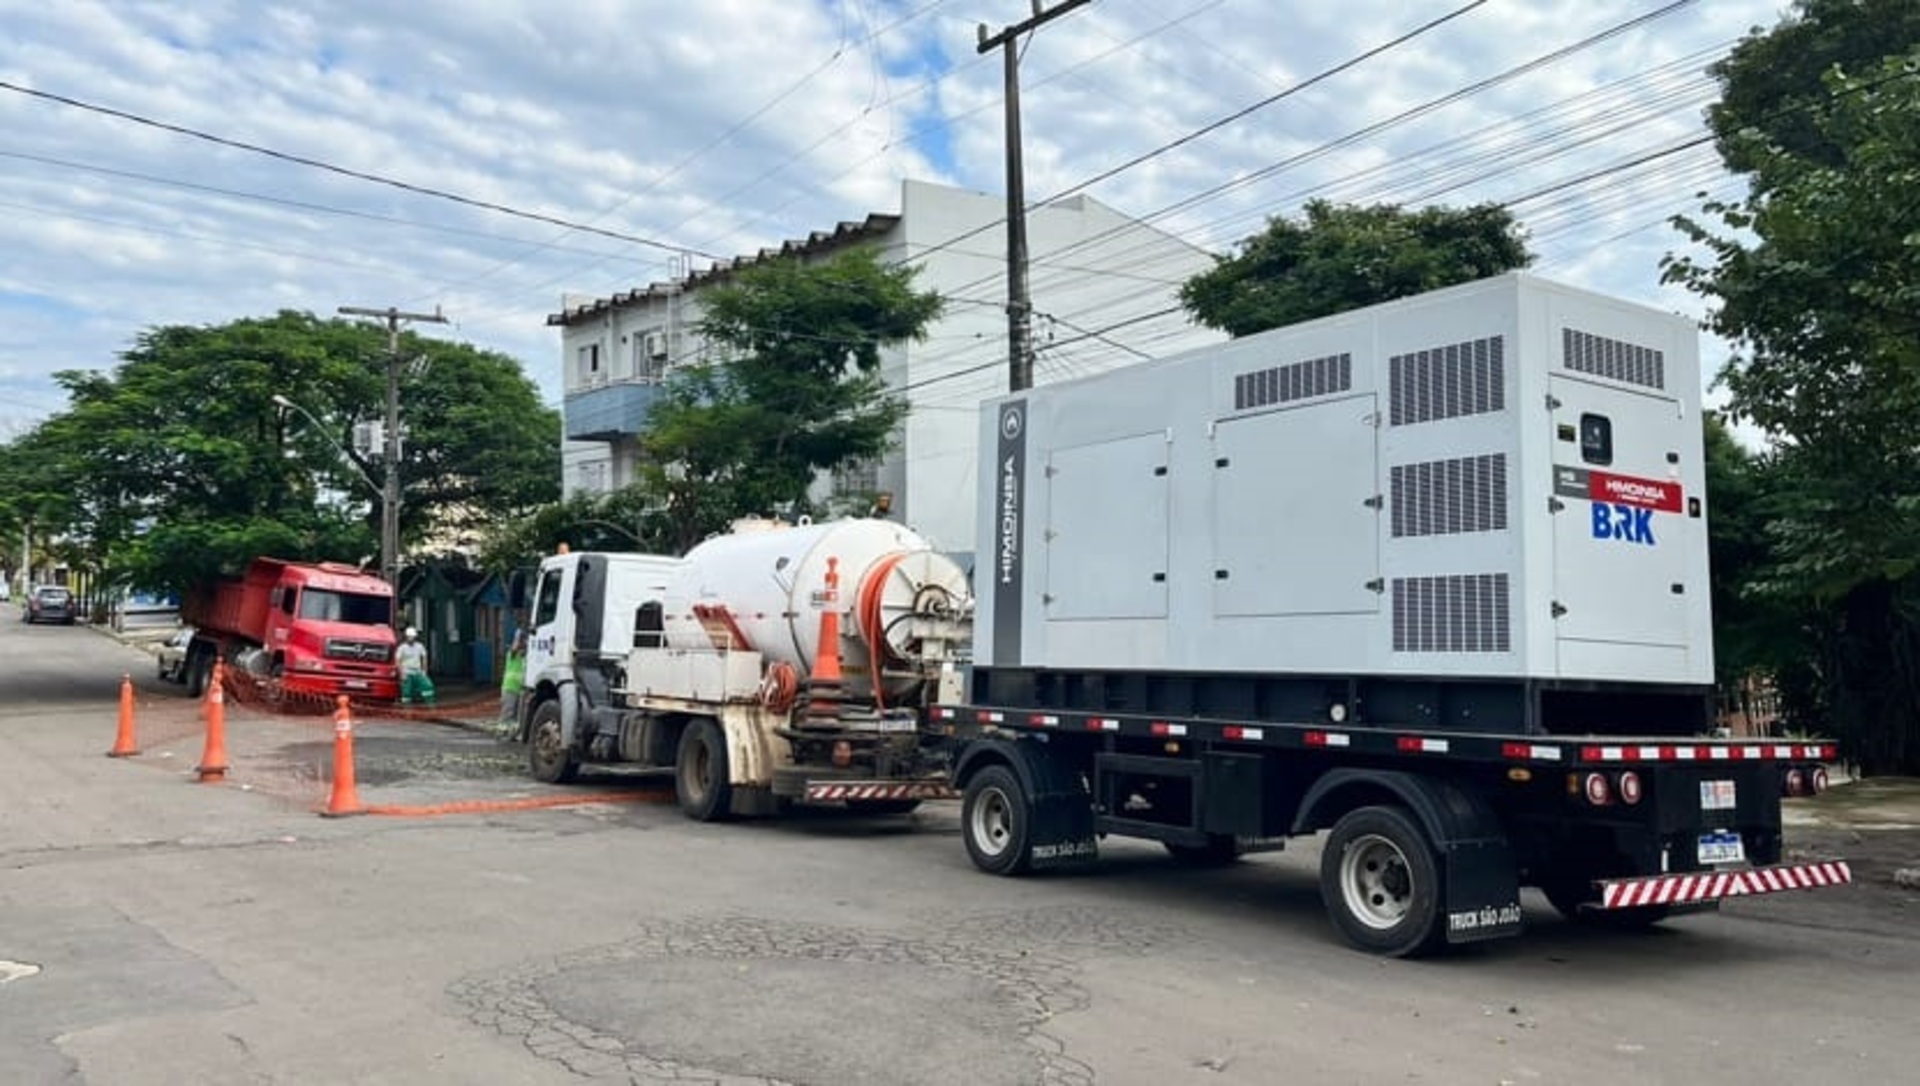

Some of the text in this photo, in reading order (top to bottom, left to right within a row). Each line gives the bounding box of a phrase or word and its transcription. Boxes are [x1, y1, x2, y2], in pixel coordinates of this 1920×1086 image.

[1592, 502, 1655, 545] BRK
[1450, 902, 1520, 930] TRUCK SÃO JOÃO
